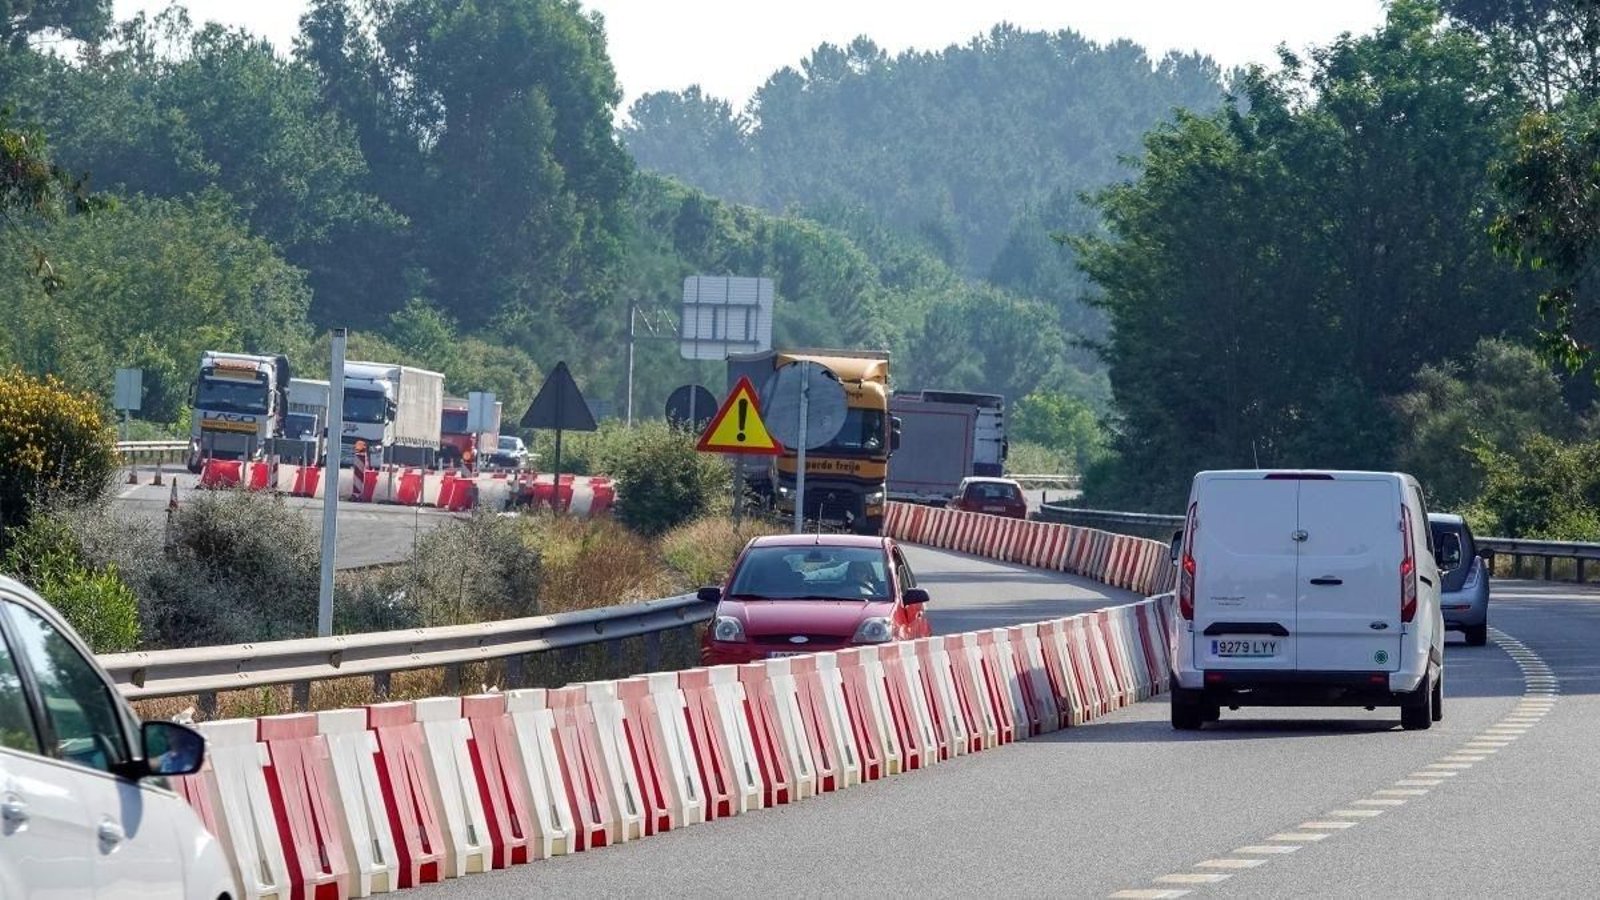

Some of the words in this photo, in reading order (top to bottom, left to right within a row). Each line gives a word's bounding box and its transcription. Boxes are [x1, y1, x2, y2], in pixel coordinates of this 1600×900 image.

[203, 411, 256, 423] LASO
[1219, 641, 1250, 653] 9279
[1253, 641, 1277, 653] LYY
